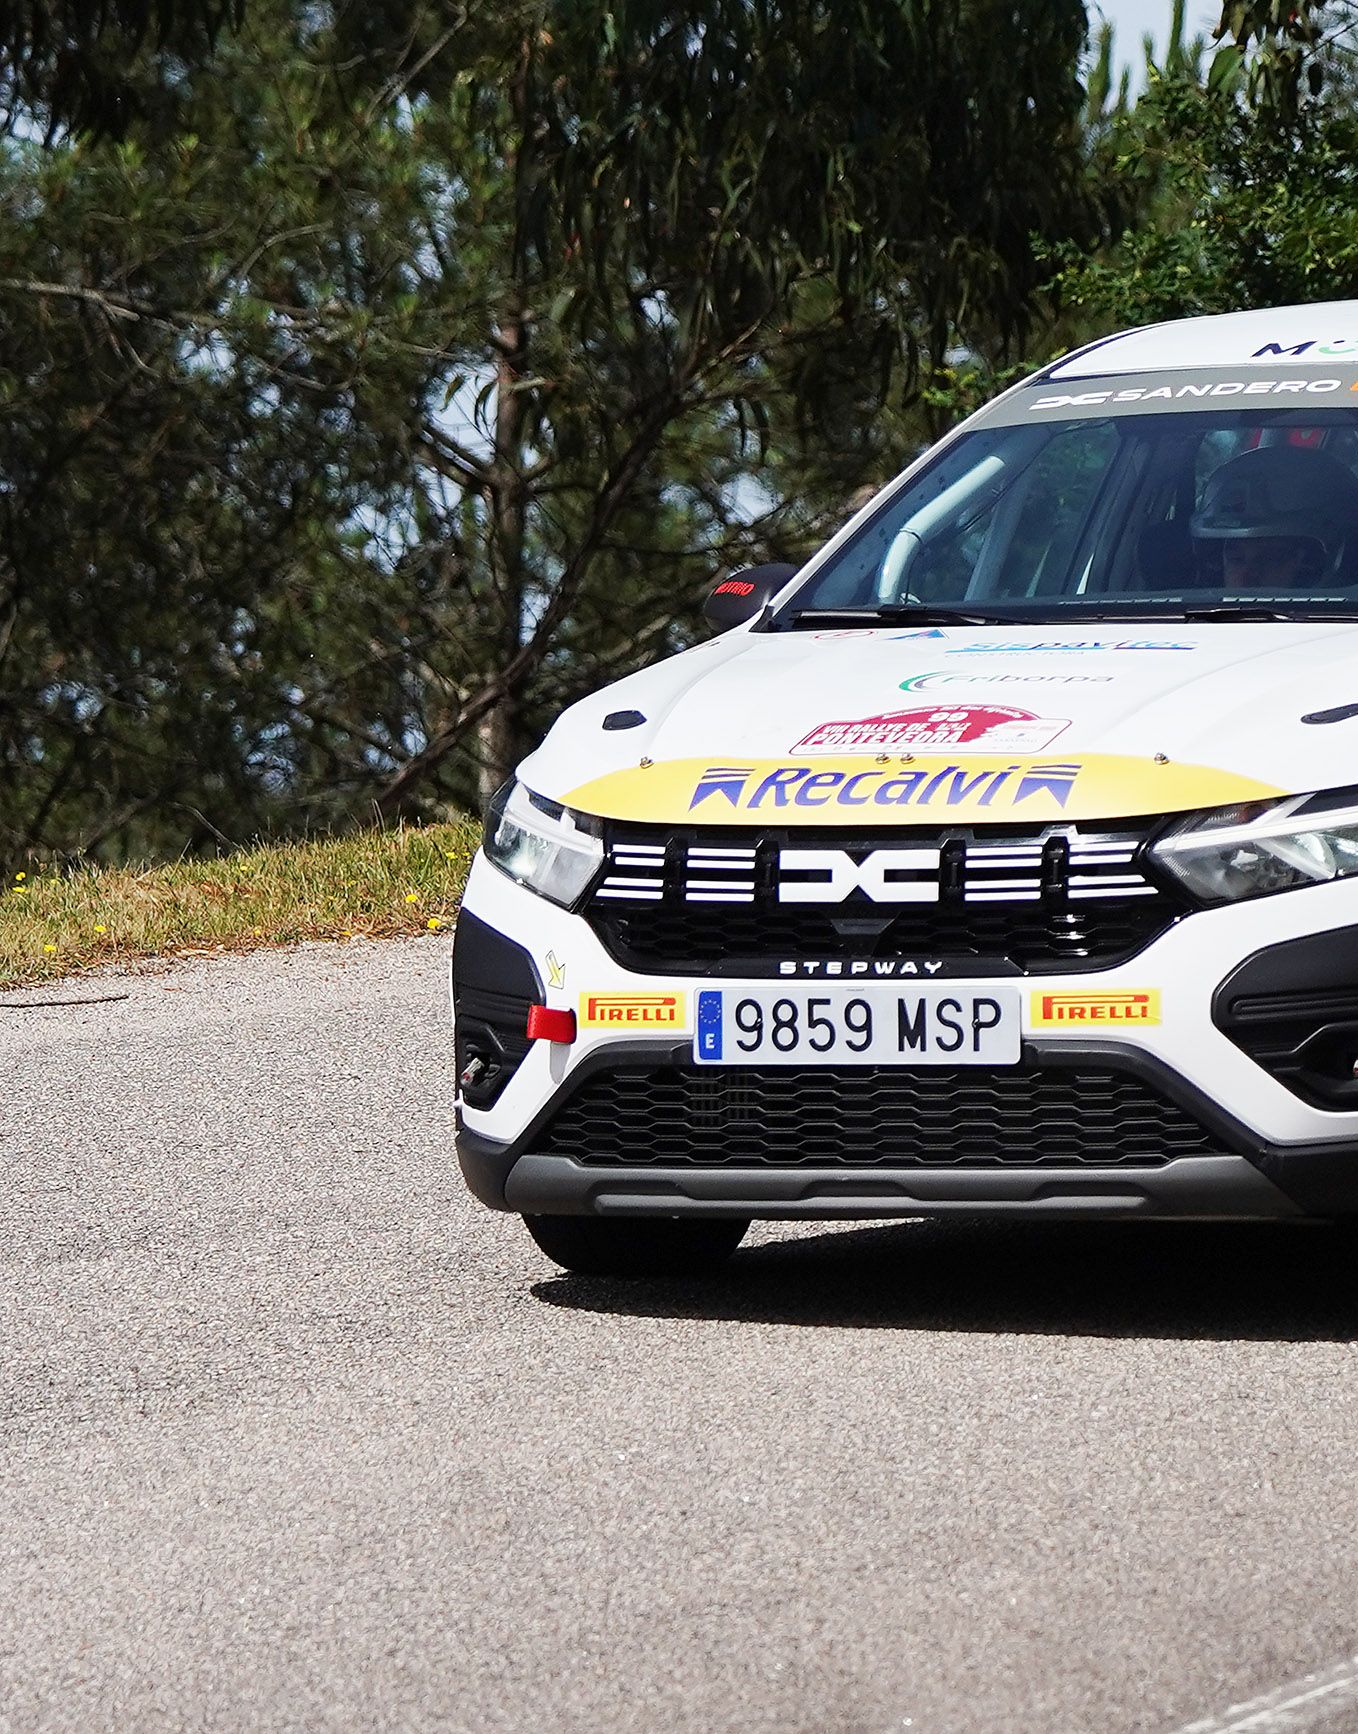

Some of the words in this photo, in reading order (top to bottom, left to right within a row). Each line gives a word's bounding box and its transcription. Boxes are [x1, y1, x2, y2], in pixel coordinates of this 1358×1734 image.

[1111, 378, 1342, 402] SANDERO
[928, 711, 970, 722] 99
[806, 730, 964, 745] PONTEVEDRA
[848, 722, 907, 733] RALLYE
[905, 722, 931, 733] DE
[747, 764, 1021, 810] Recalvi
[778, 959, 945, 976] STEPWAY
[586, 996, 677, 1023] PIRELLI
[1041, 994, 1151, 1021] PIRELLI
[734, 998, 873, 1053] 9859
[897, 998, 1002, 1053] MSP
[704, 1032, 716, 1050] E
